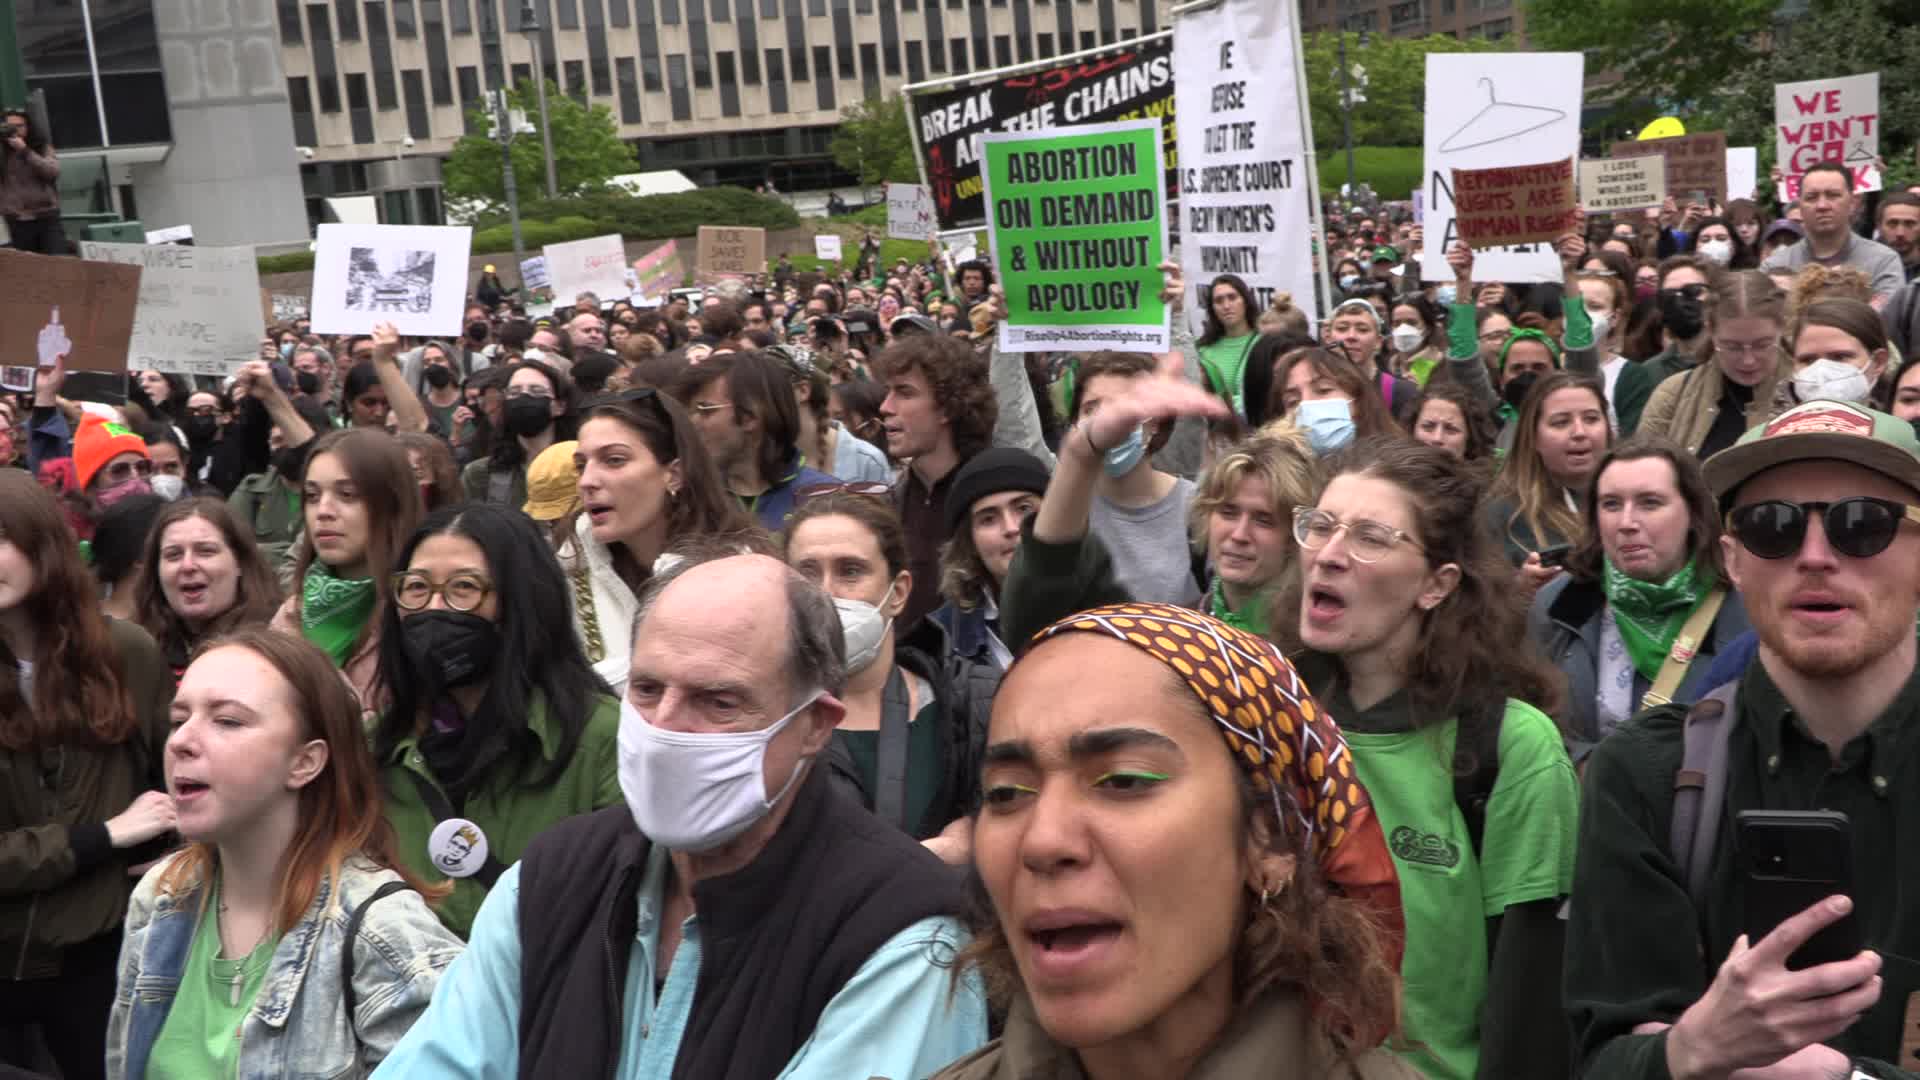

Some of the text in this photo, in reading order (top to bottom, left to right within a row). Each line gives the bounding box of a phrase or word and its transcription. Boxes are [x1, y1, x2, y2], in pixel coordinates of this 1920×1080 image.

[920, 89, 994, 143] BREAK
[1793, 89, 1841, 115] WE
[1001, 102, 1056, 135] THE
[1780, 114, 1877, 145] WON'T
[1231, 121, 1255, 151] THE
[1007, 142, 1137, 185] ABORTION
[1611, 160, 1638, 171] LOVE
[1790, 140, 1844, 174] GO
[1244, 159, 1293, 191] COURT
[1598, 172, 1645, 184] SOMEONE
[1598, 183, 1648, 195] WHO HAD
[1785, 164, 1873, 202] BK
[997, 189, 1155, 229] ON DEMAND
[1456, 186, 1562, 213] RIGHTS ARE
[1589, 194, 1657, 207] AN ABORTION
[1216, 203, 1275, 233] WOMEN'S
[1010, 235, 1150, 272] & WITHOUT
[1027, 279, 1141, 313] APOLOGY
